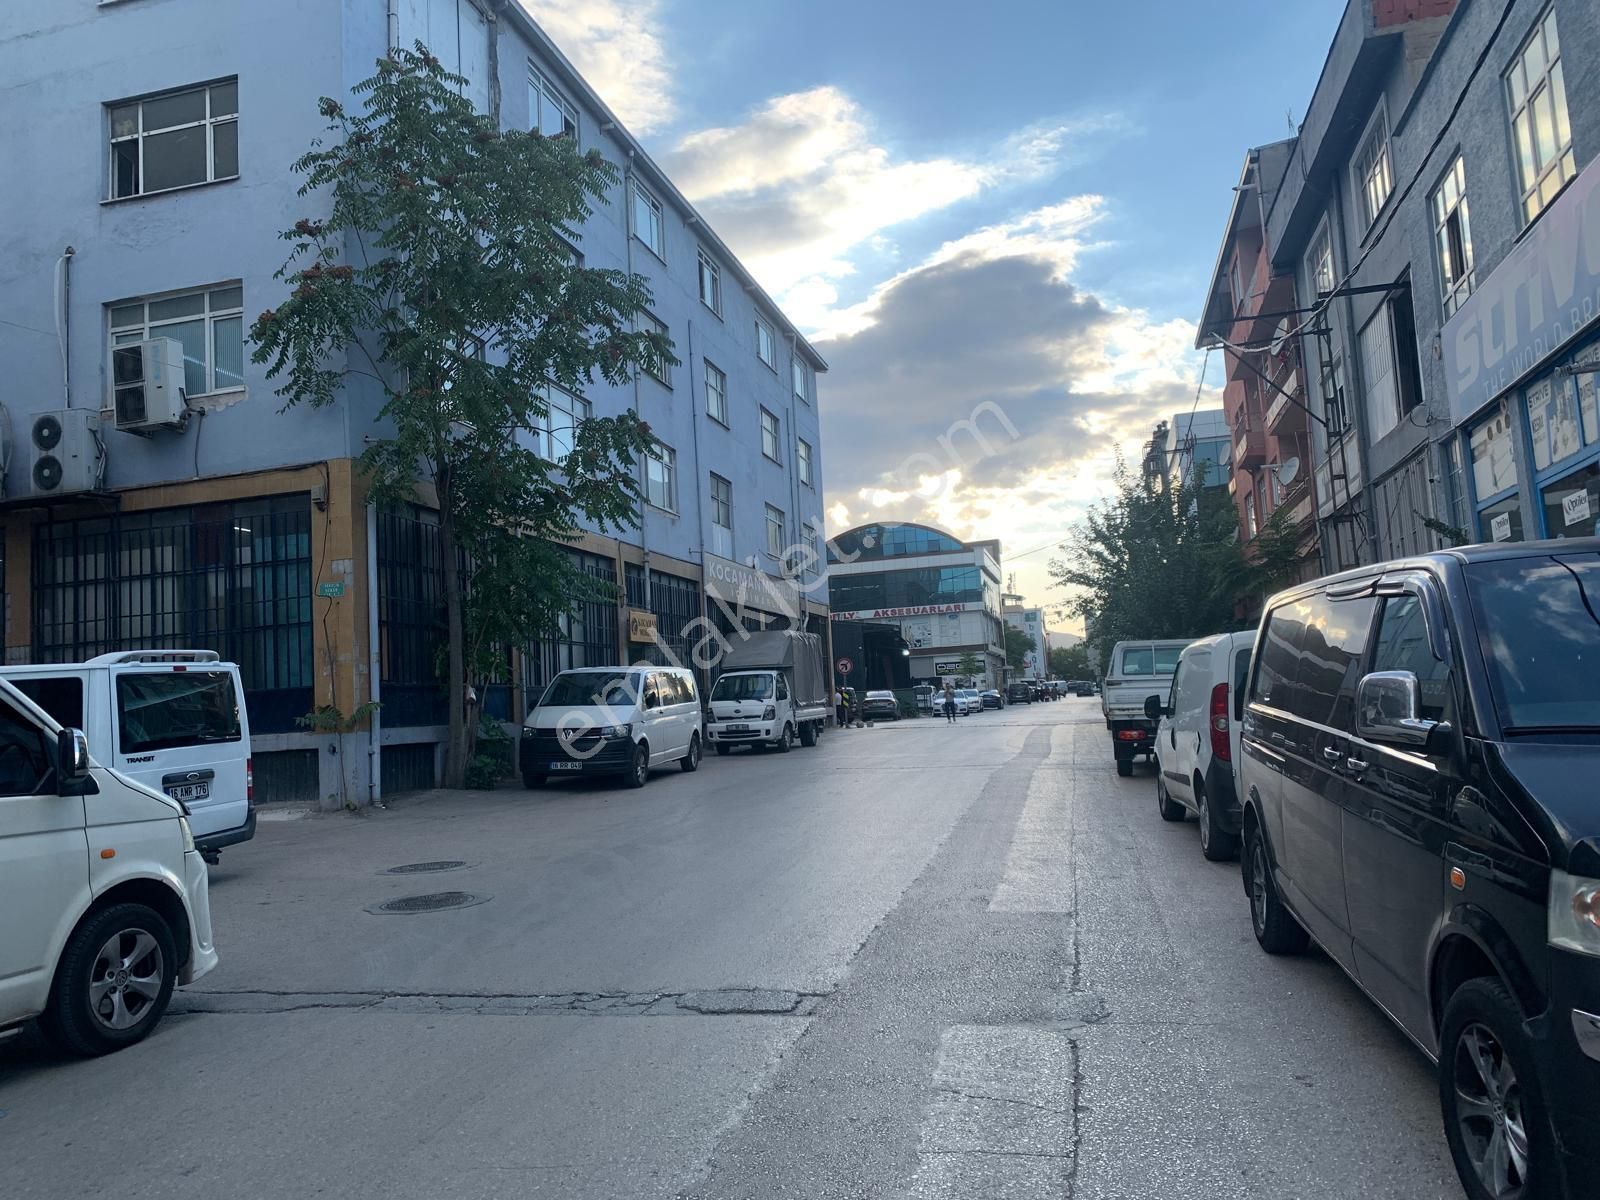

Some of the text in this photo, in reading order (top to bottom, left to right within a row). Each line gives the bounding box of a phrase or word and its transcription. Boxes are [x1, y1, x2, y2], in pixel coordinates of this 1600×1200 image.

[1483, 366, 1507, 398] THE
[1511, 321, 1563, 377] WORLD
[1527, 383, 1549, 408] STRIVE
[709, 561, 762, 592] KOCAMAN
[126, 755, 155, 764] TRANSIT
[170, 787, 178, 798] 16
[195, 784, 207, 796] 176
